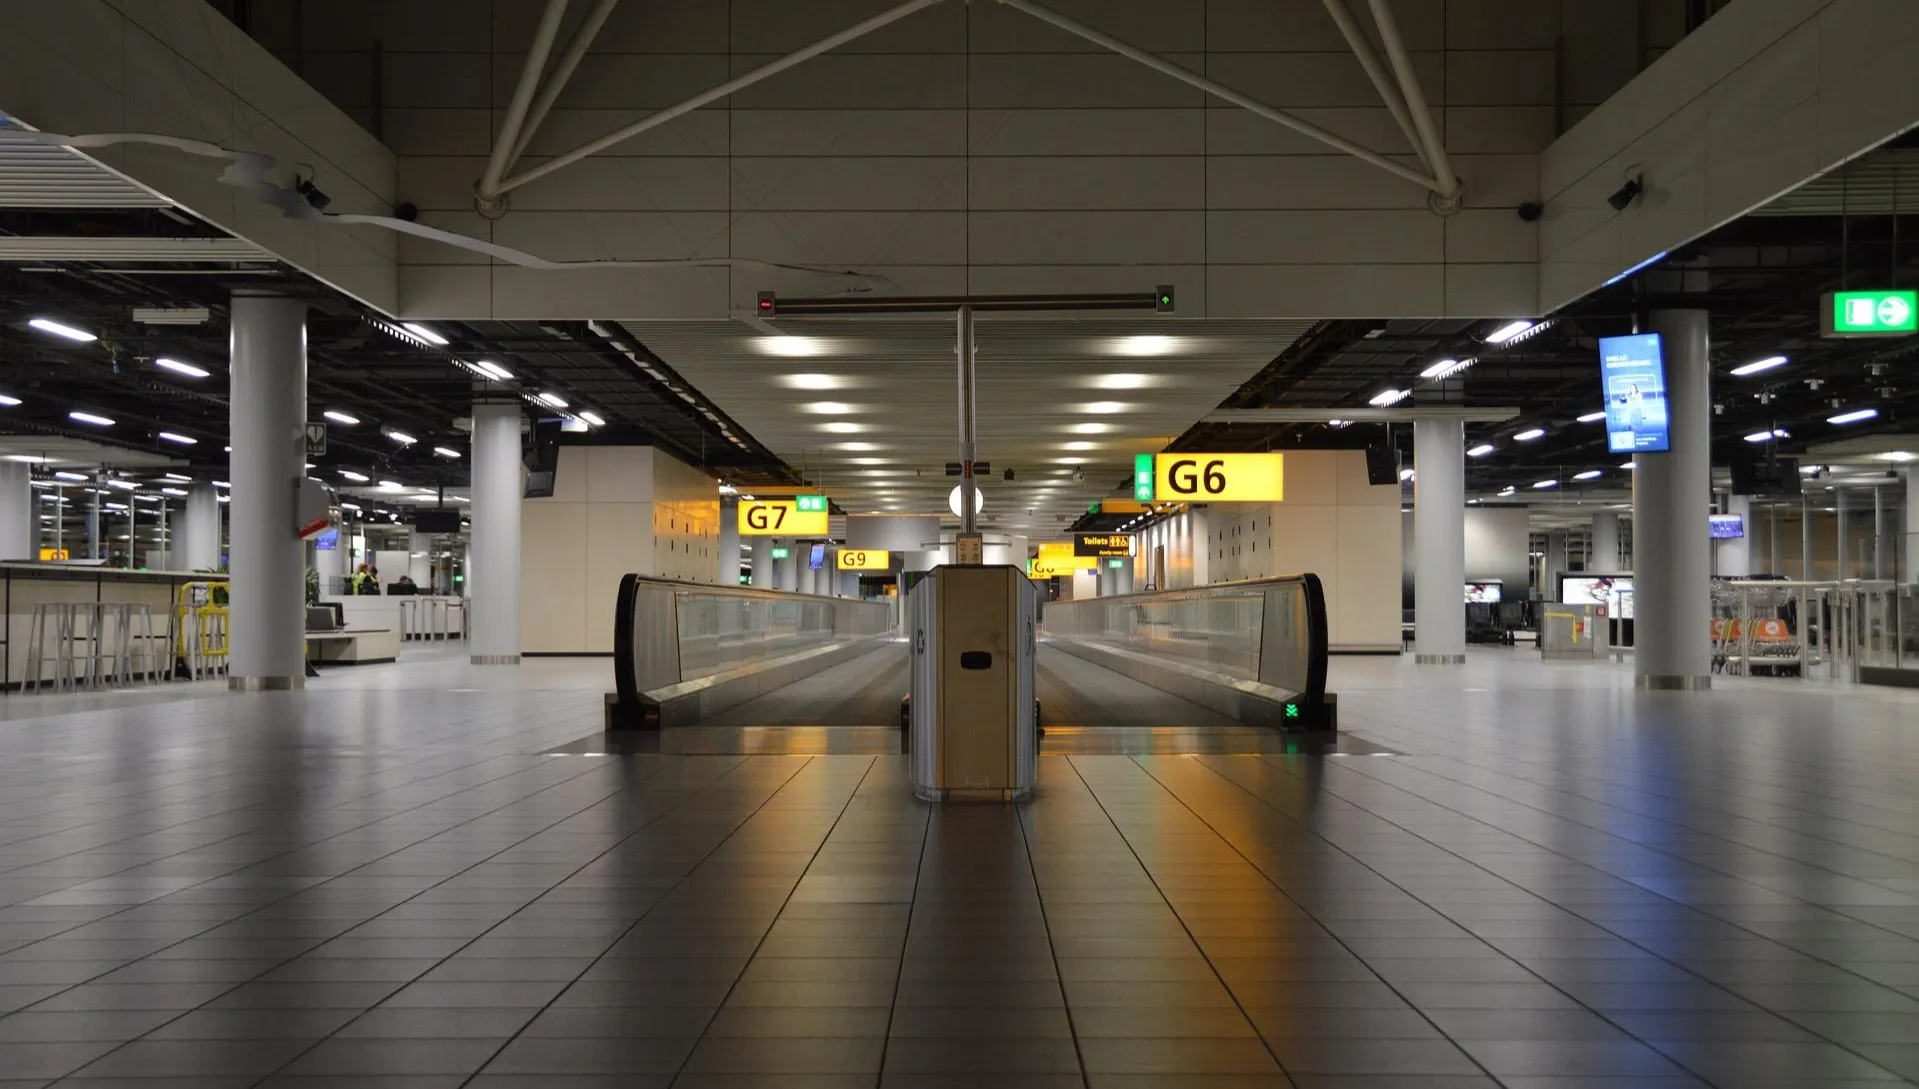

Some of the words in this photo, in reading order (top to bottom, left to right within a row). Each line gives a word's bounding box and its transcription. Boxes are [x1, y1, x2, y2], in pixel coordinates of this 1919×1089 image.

[1168, 460, 1226, 494] G6
[747, 506, 787, 529] G7
[1084, 537, 1108, 545] Toilets
[843, 552, 866, 566] G9
